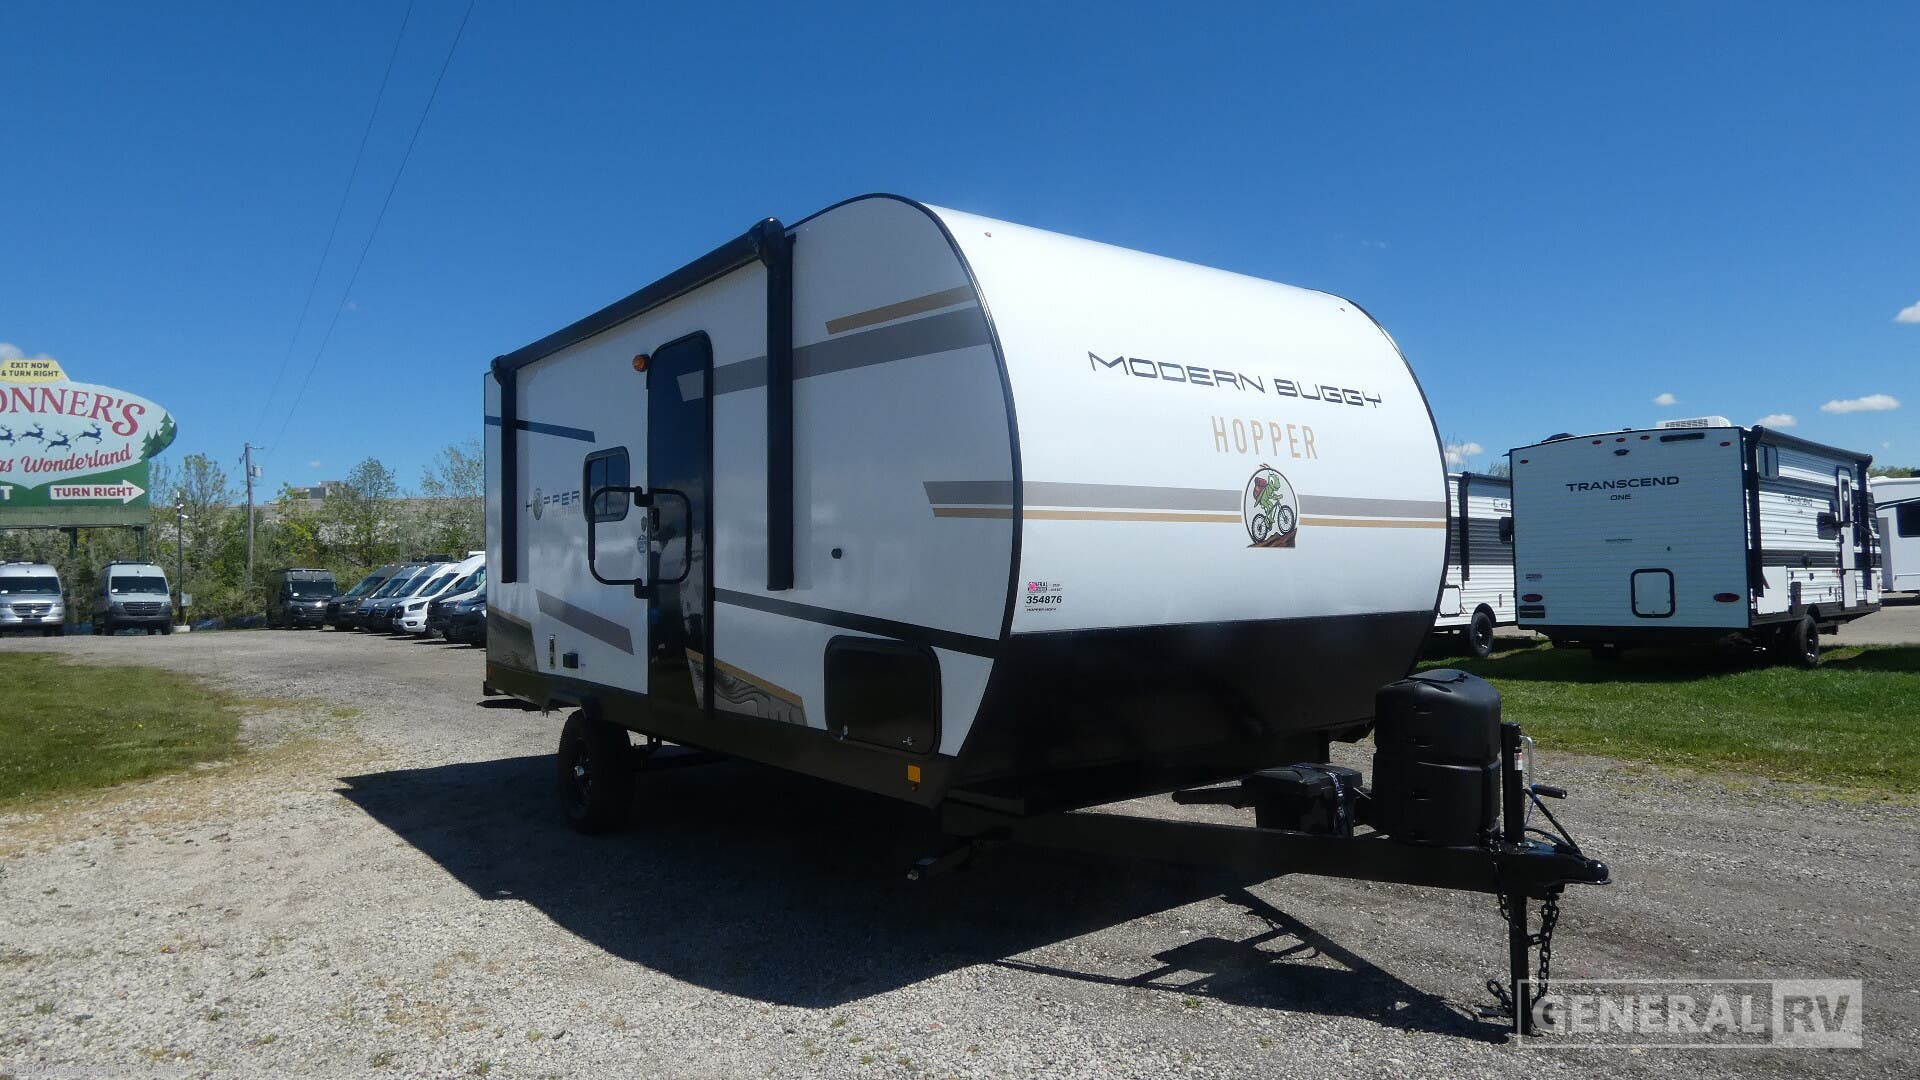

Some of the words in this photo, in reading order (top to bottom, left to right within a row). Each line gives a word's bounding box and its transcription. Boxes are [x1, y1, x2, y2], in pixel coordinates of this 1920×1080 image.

[1087, 350, 1266, 394] MODERN
[1273, 378, 1383, 408] BUGGY
[0, 386, 146, 437] NNER'S
[1211, 415, 1319, 460] HOPPER
[20, 443, 133, 473] Wonderland
[54, 487, 91, 497] TURN
[94, 487, 134, 497] RIGHT
[1565, 476, 1680, 492] TRANSCEND
[1610, 493, 1632, 501] ONE
[1025, 595, 1063, 604] 354876
